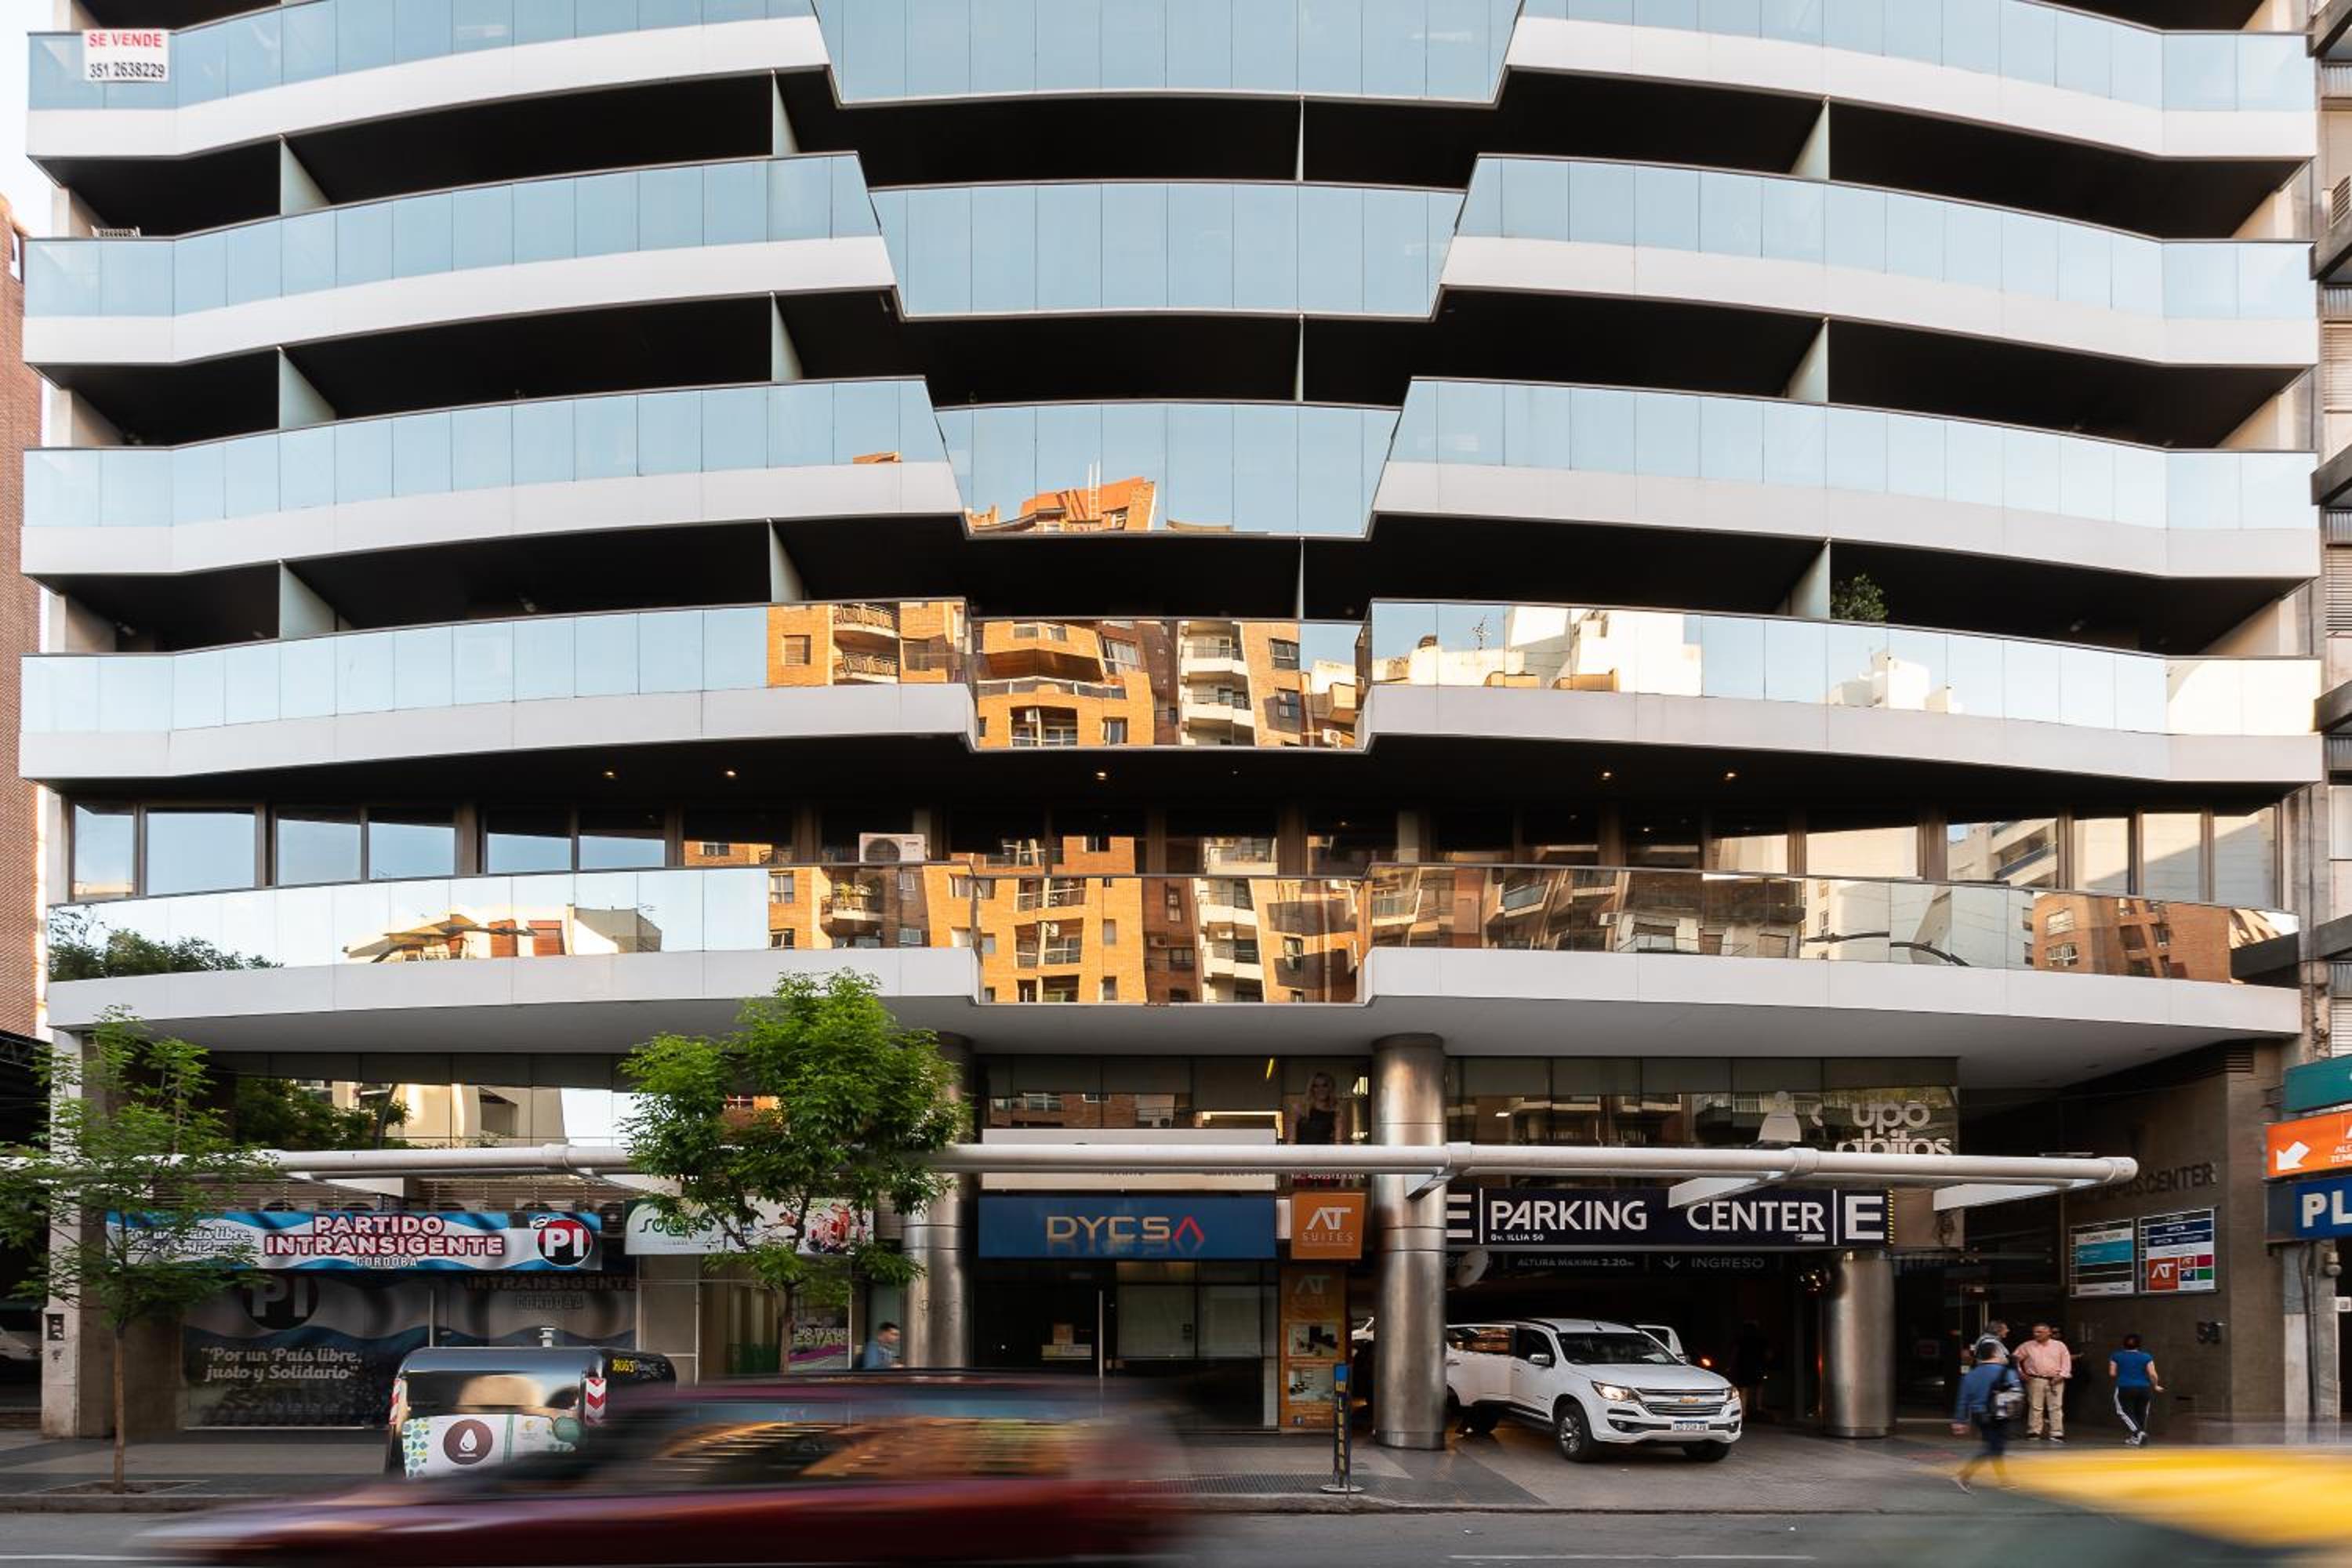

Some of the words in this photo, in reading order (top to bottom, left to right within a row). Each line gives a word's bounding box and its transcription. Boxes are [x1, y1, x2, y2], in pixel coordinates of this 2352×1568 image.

[89, 34, 107, 47] SE
[112, 34, 162, 47] VENDE
[90, 64, 109, 78] 351
[114, 63, 165, 78] 2638229
[314, 1215, 445, 1235] PARTIDO
[1305, 1207, 1353, 1231] AT
[1490, 1200, 1647, 1231] PARKING
[1686, 1200, 1826, 1232] CENTER
[1845, 1196, 1884, 1240] E
[1046, 1215, 1205, 1243] DYCSA
[1302, 1232, 1355, 1243] SUITES
[265, 1235, 503, 1255] INTRANSIGENTE
[544, 1228, 585, 1257] PI
[1691, 1257, 1764, 1269] INGRESO
[252, 1276, 308, 1317] PI
[246, 1348, 268, 1363] un
[317, 1348, 362, 1363] libre,
[205, 1364, 251, 1381] justo
[254, 1367, 264, 1382] y
